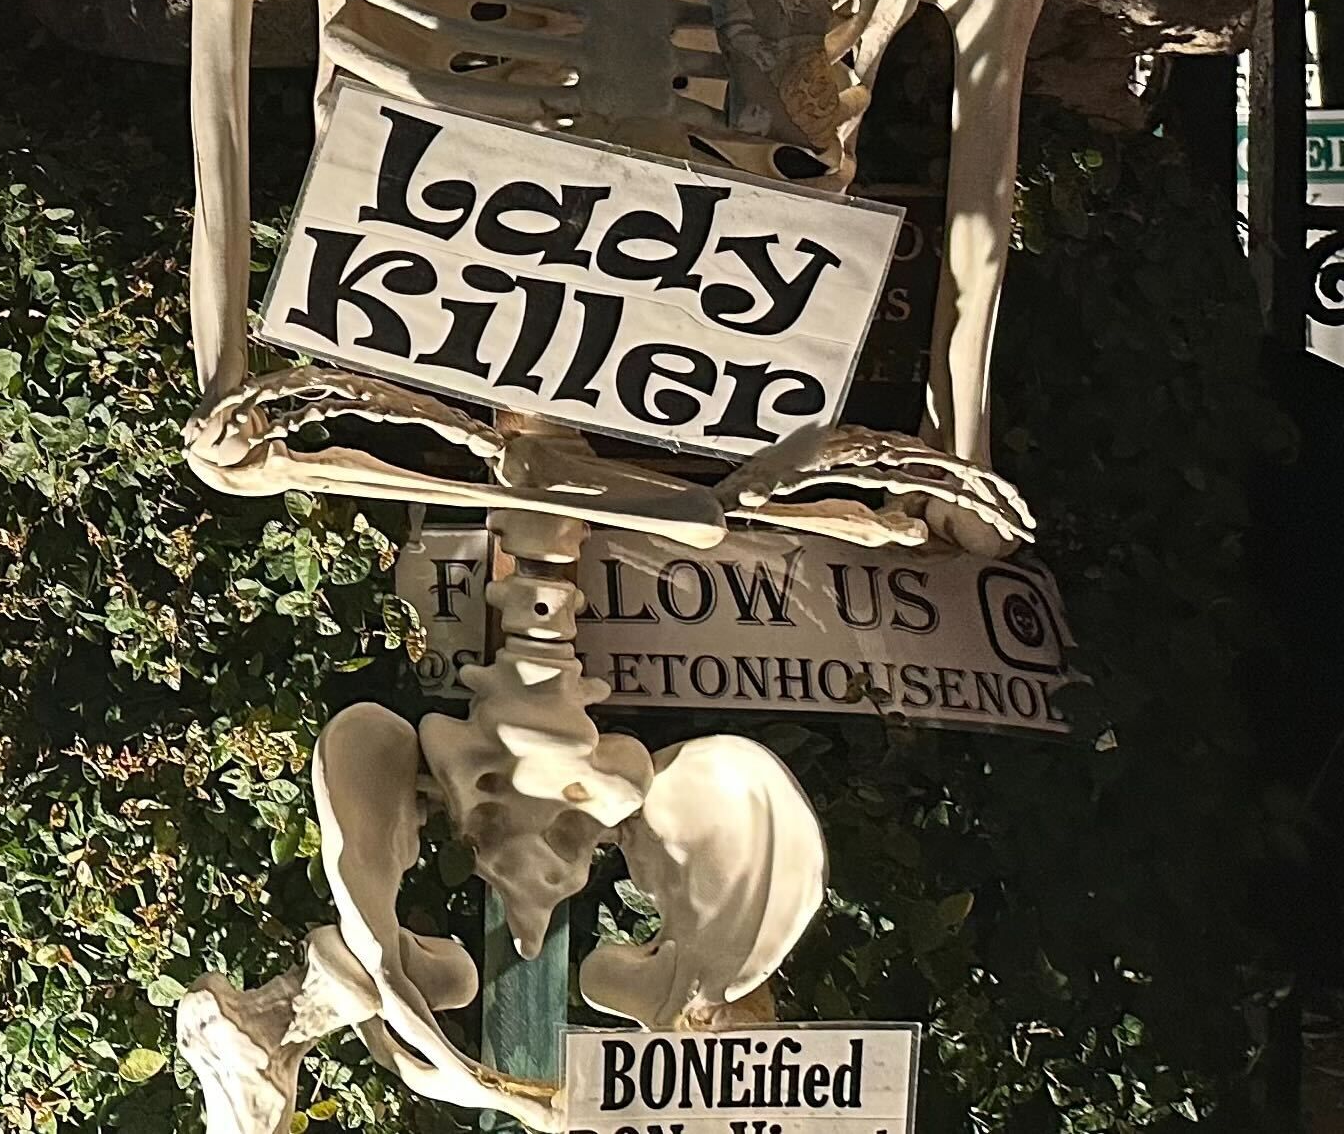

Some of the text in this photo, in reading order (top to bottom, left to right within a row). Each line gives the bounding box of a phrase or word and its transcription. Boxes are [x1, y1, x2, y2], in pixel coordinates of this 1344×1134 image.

[357, 105, 842, 337] Lady
[285, 226, 828, 444] Killer
[429, 545, 940, 635] FLOW US
[600, 1036, 865, 1112] BONEified
